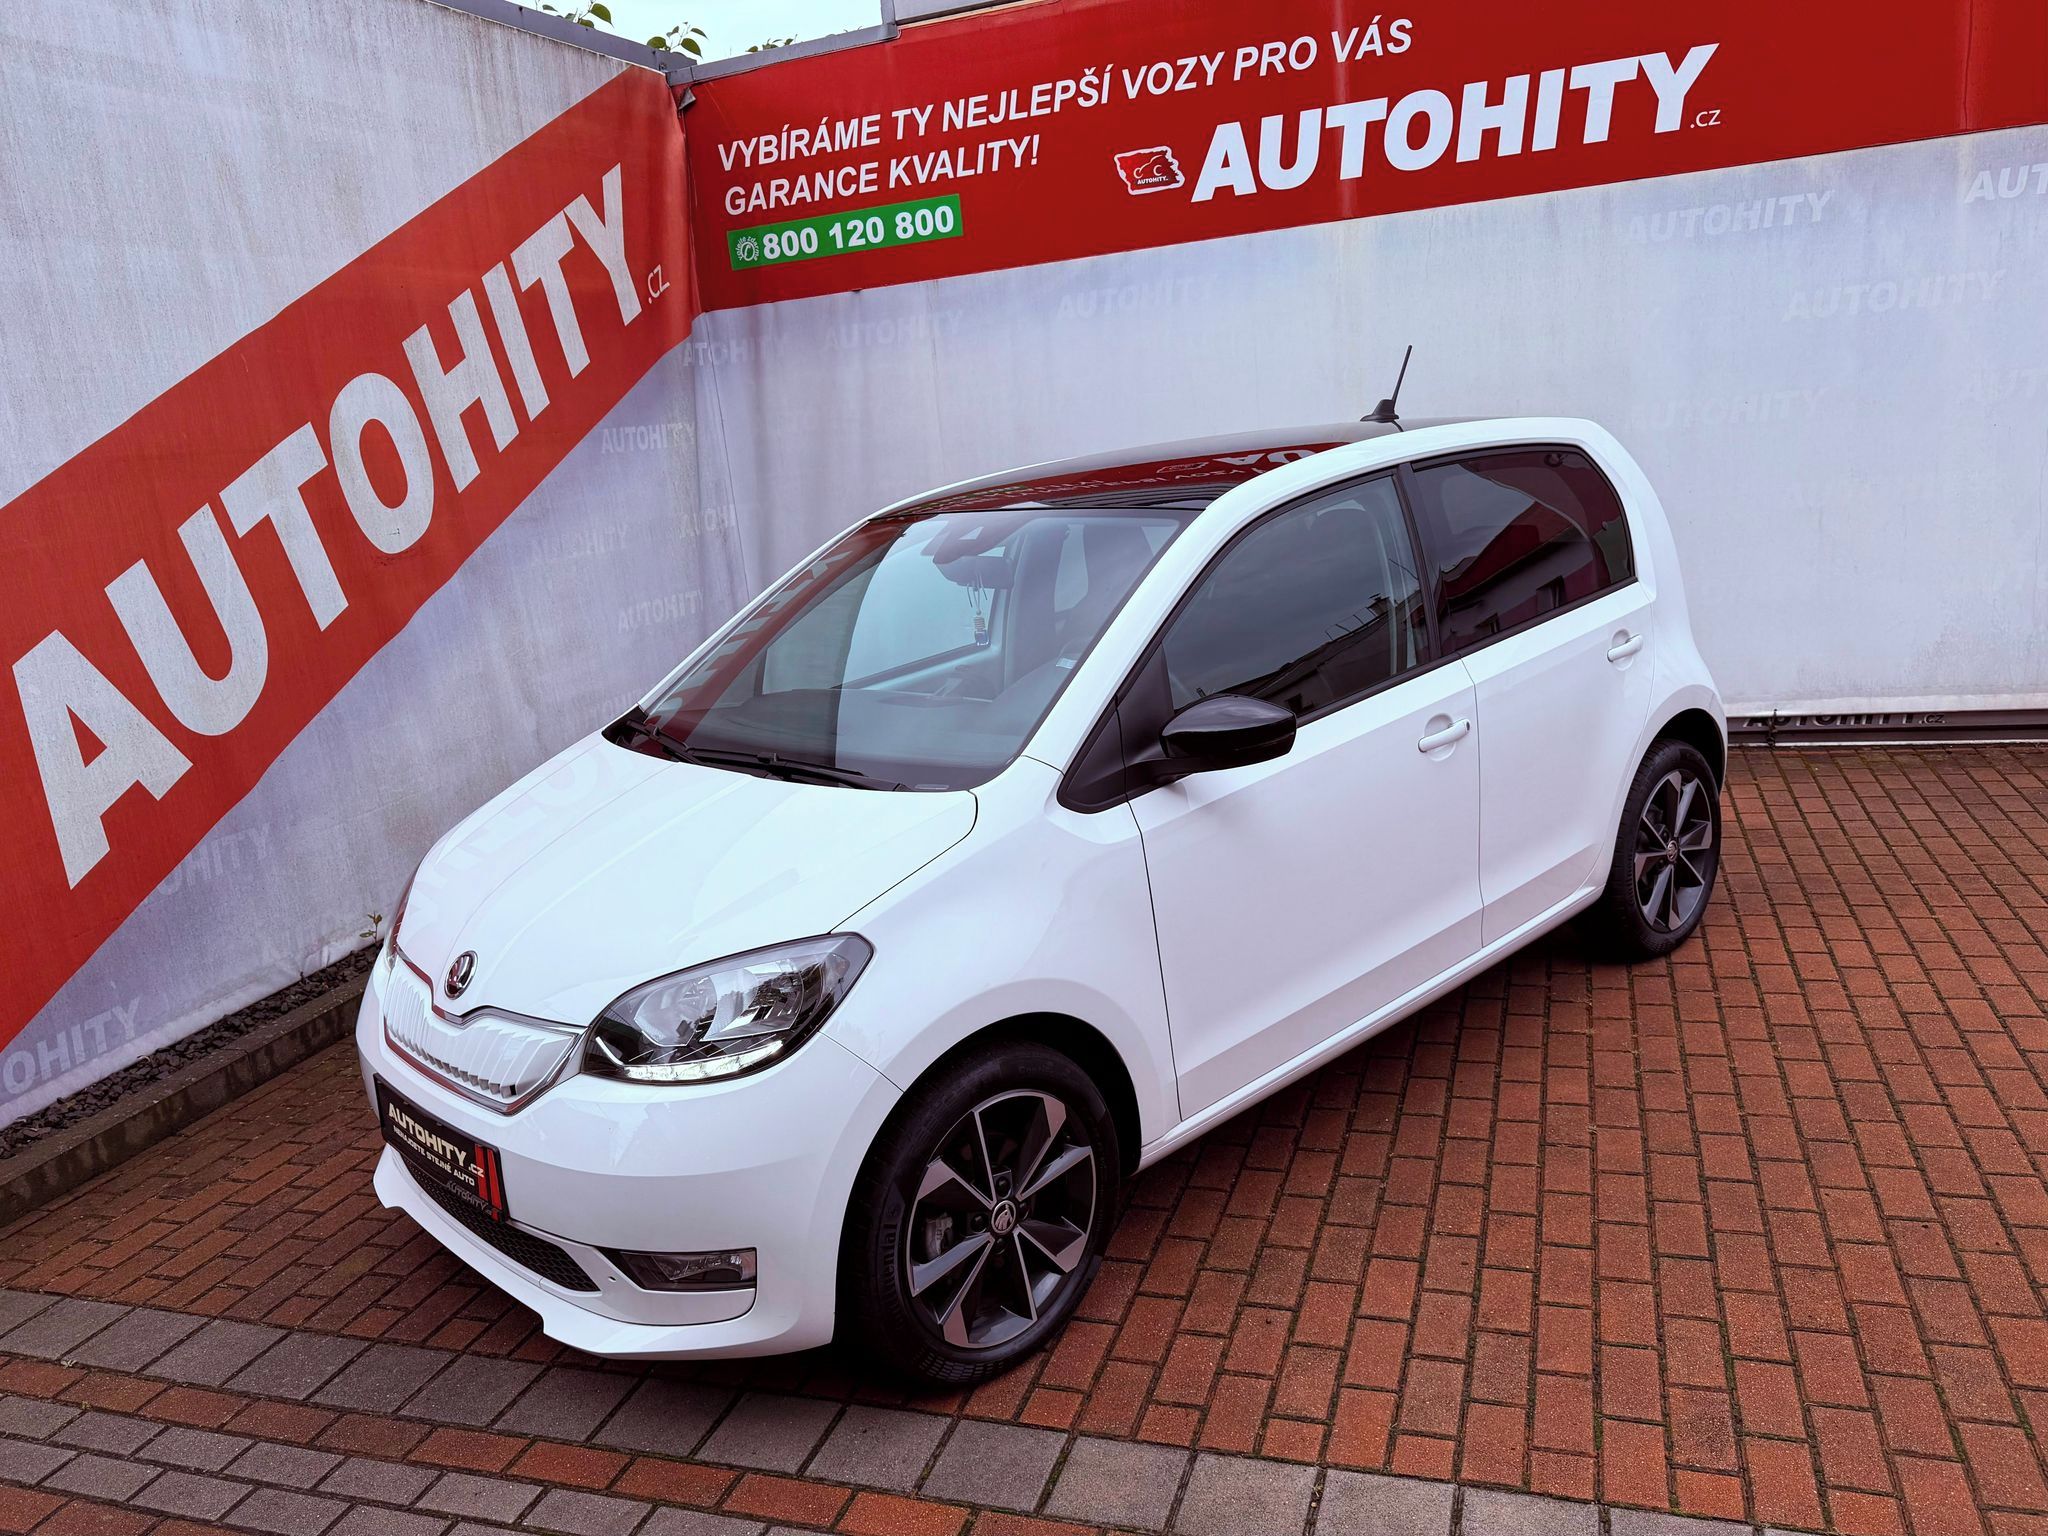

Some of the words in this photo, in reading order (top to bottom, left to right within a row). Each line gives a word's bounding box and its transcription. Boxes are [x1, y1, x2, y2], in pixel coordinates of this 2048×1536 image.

[717, 114, 881, 172] VYBÍRÁME
[892, 105, 934, 140] TY
[941, 64, 1114, 132] NEJLEPŠÍ
[1121, 52, 1225, 99] VOZY
[1232, 36, 1318, 82] PRO
[1330, 15, 1414, 63] VÁS
[724, 158, 879, 216] GARANCE
[889, 134, 1042, 190] KVALITY!
[762, 227, 819, 260] 800
[828, 216, 885, 249] 120
[895, 205, 954, 239] 800
[454, 1169, 475, 1186] AUTO
